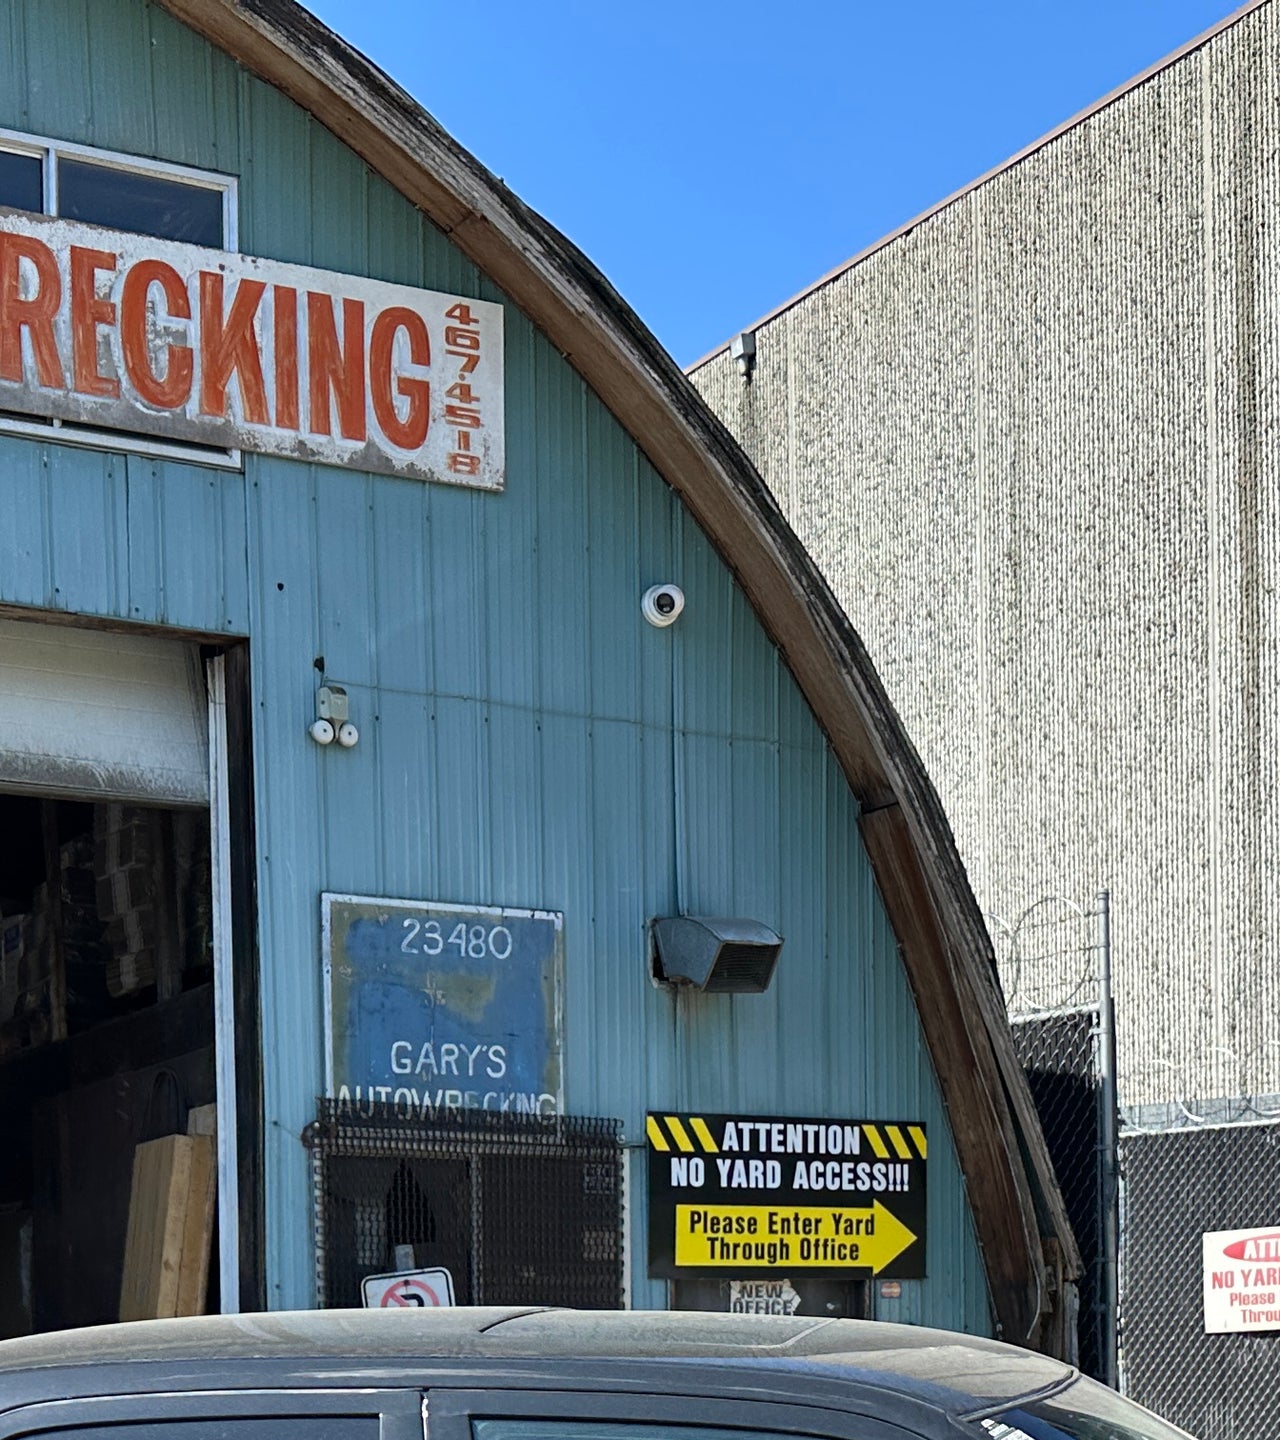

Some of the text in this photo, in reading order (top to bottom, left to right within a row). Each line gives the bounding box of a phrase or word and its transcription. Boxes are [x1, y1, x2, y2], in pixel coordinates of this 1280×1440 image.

[401, 918, 513, 960] 23480
[390, 1040, 507, 1079] GARY'S
[721, 1121, 861, 1155] ATTENTION
[670, 1157, 910, 1192] NO YARD ACCESS!!!
[689, 1210, 876, 1236] Please Enter Yard
[706, 1236, 860, 1264] Through Office
[740, 1283, 784, 1299] NEW
[1211, 1270, 1235, 1290] NO
[732, 1299, 794, 1315] OFFICE
[1229, 1291, 1276, 1307] Please
